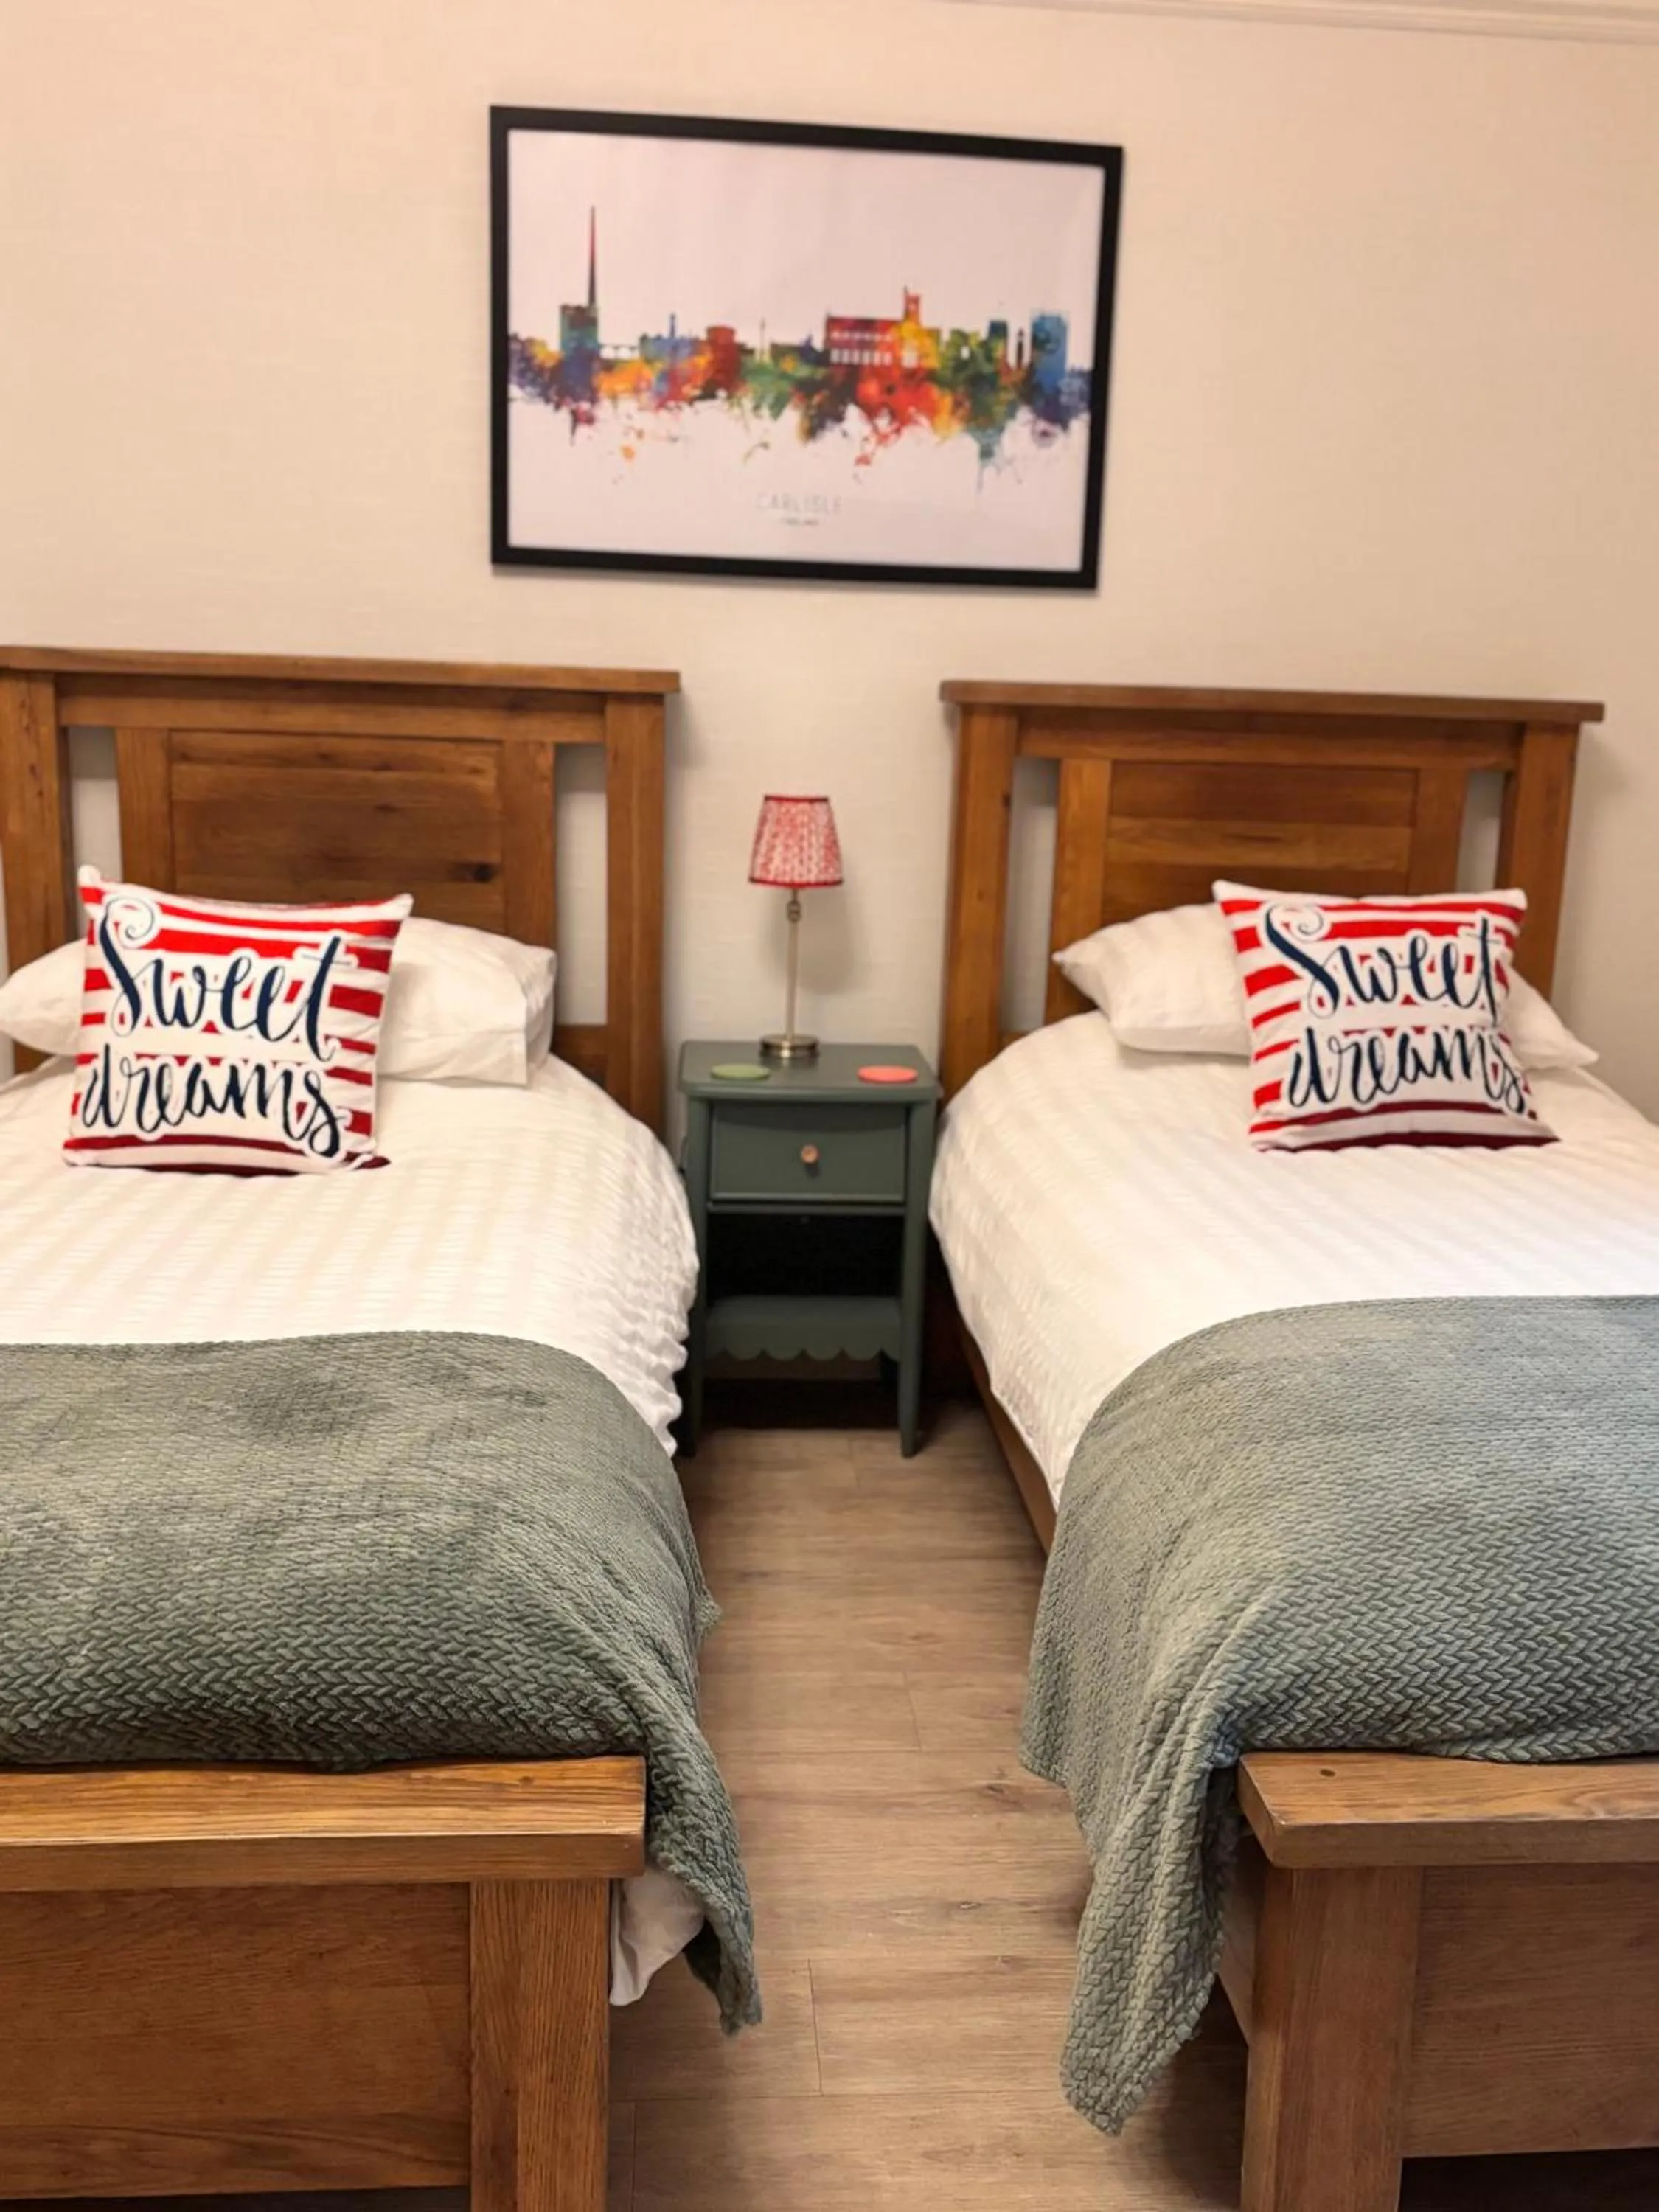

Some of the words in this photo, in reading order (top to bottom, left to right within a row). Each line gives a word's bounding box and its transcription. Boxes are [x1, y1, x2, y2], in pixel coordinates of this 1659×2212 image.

[99, 896, 352, 1062] Sweet
[1265, 906, 1501, 1028] Sweet
[82, 1043, 347, 1158] dreams
[1288, 1026, 1528, 1114] dreams
